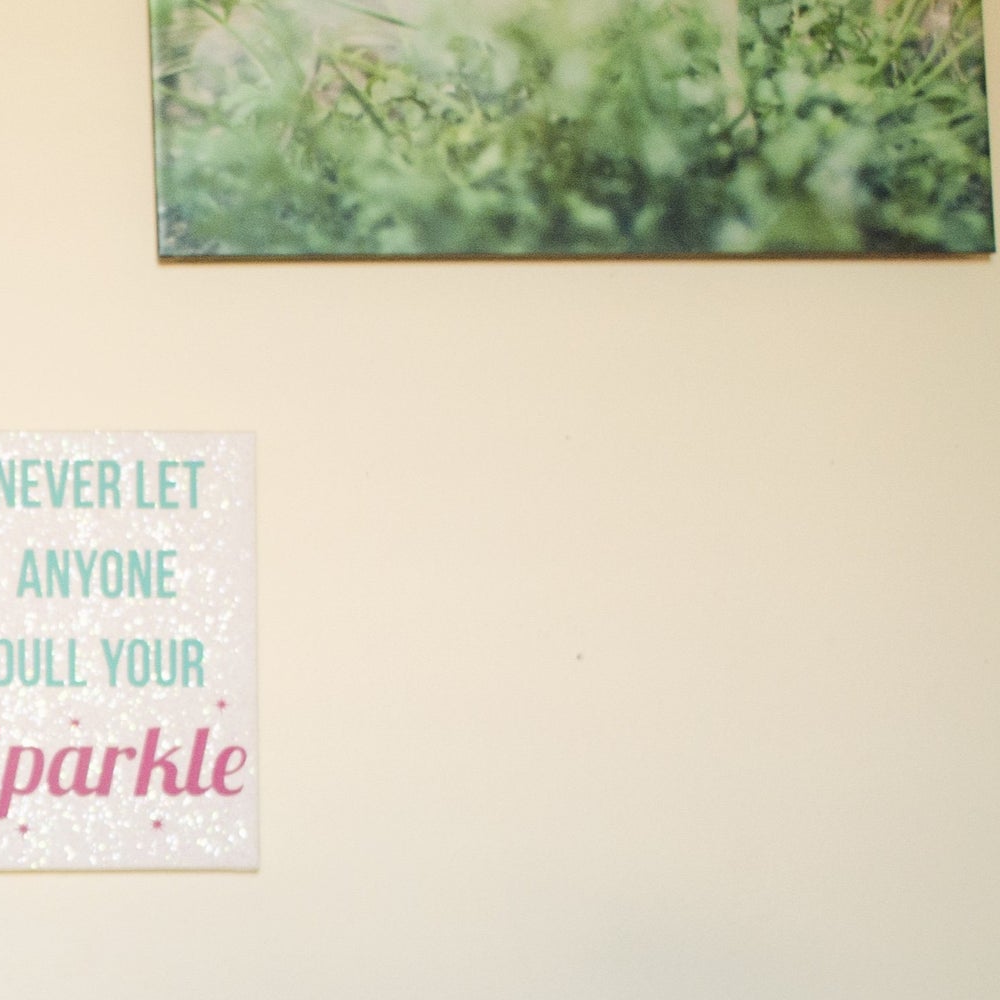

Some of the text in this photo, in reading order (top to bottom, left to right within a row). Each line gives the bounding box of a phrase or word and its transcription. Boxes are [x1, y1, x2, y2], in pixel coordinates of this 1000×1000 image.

[136, 460, 205, 509] LET
[16, 549, 178, 598] ANYONE
[102, 638, 205, 688] YOUR
